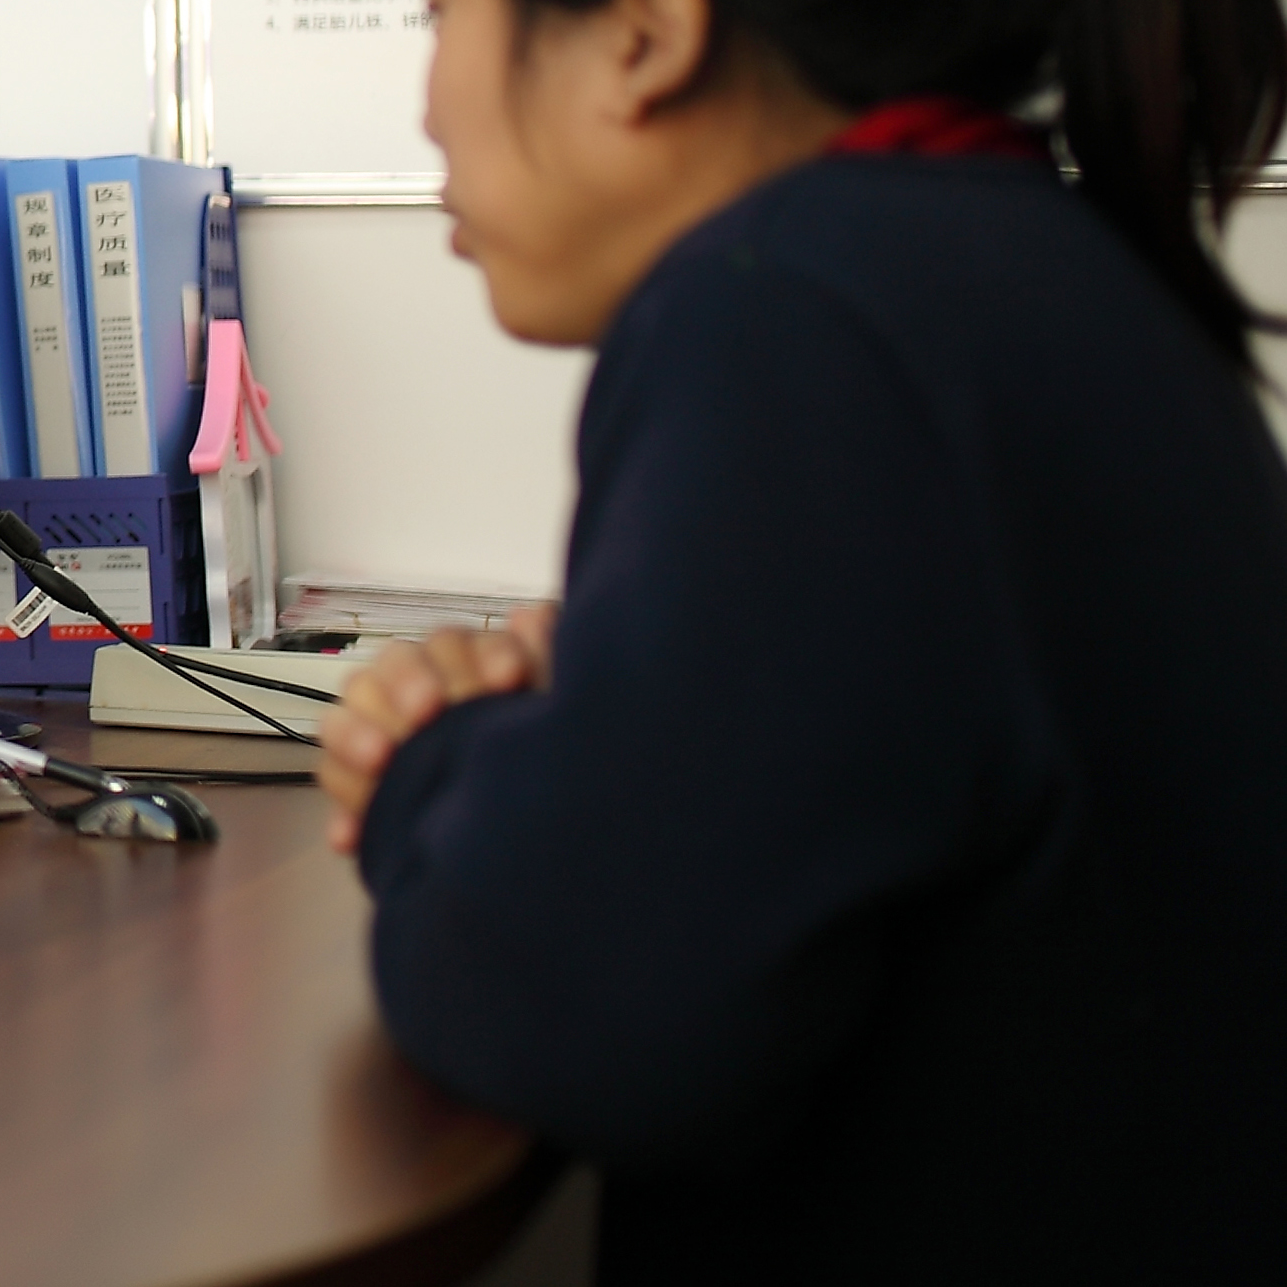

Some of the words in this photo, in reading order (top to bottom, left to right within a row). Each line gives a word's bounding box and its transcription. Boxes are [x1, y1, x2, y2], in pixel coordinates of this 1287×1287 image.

[23, 197, 55, 289] 规章制度
[94, 187, 131, 277] 医疗质量
